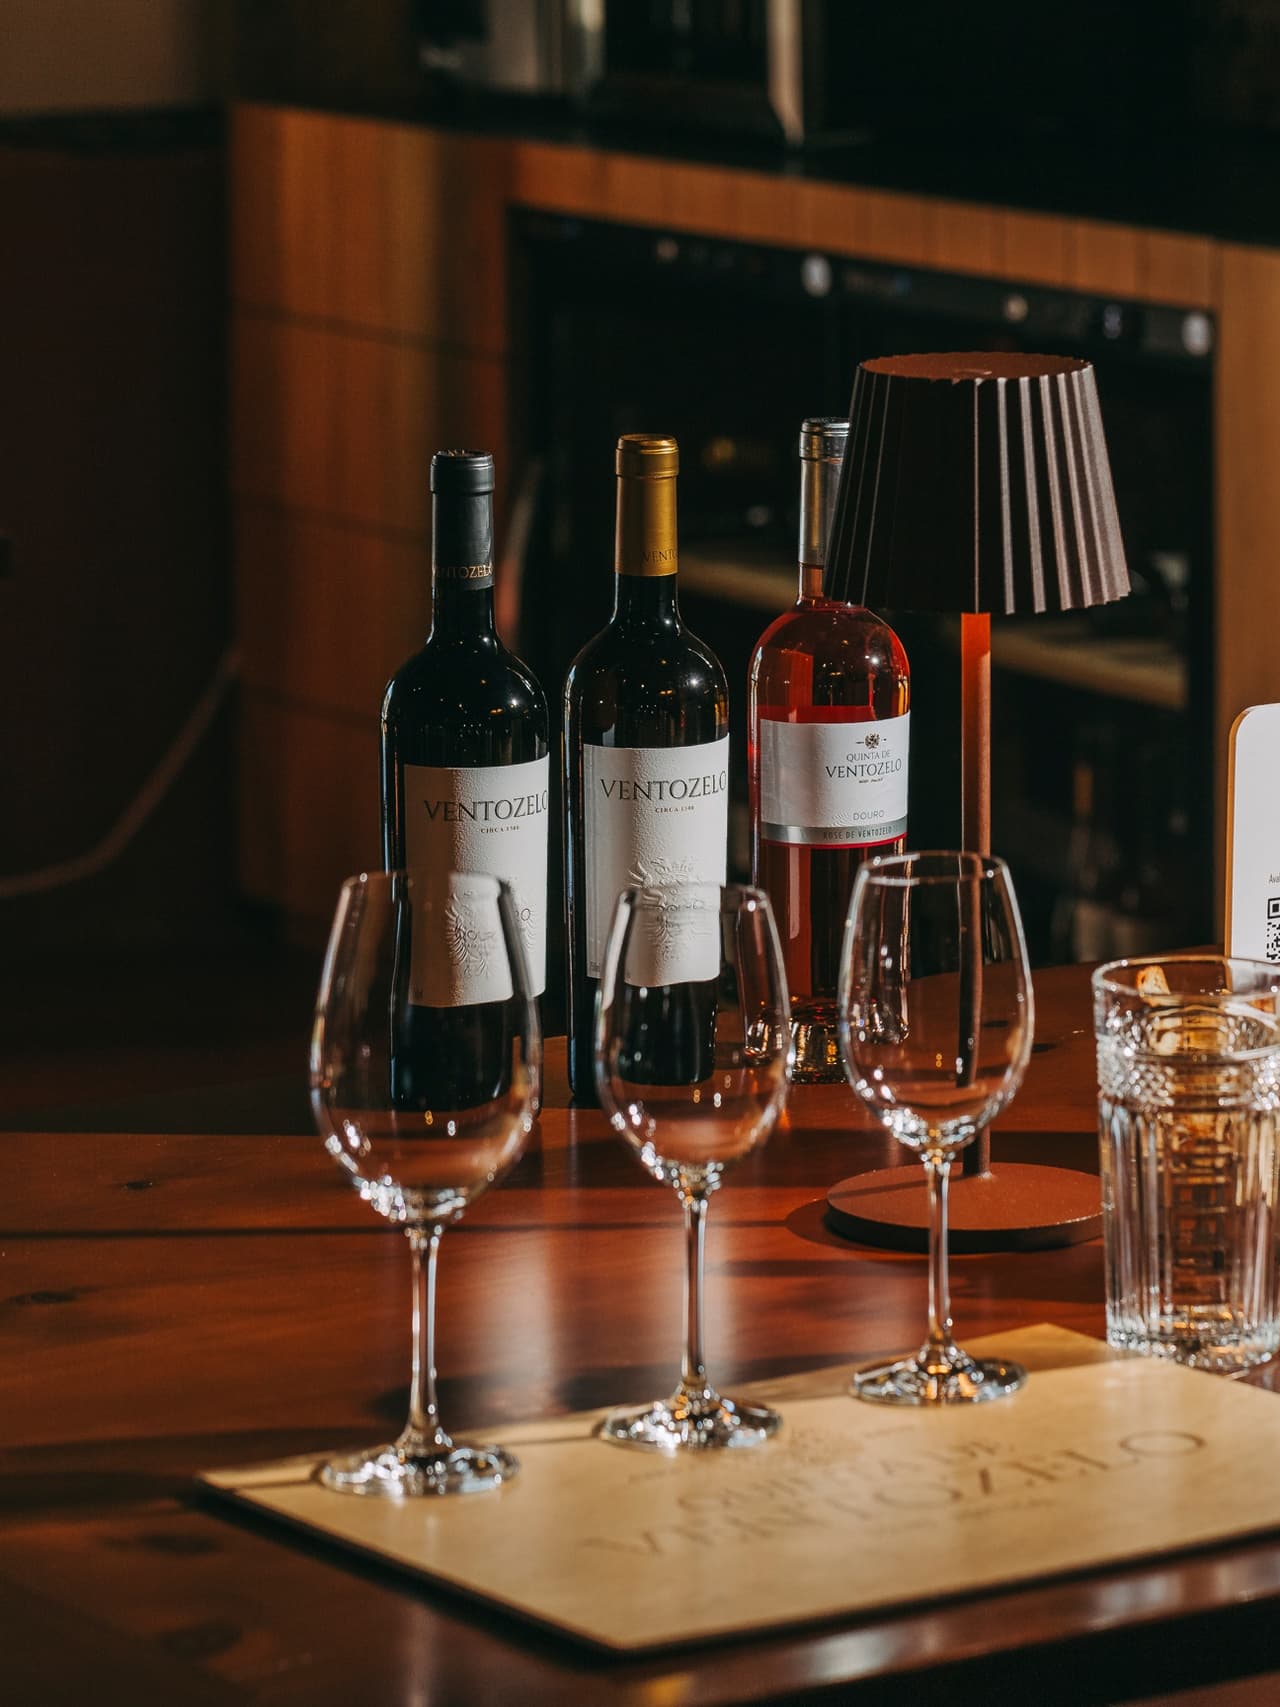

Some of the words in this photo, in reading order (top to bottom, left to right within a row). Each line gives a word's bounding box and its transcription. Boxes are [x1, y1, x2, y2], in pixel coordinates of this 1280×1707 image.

[846, 752, 880, 762] QUINTA
[881, 750, 891, 758] DE
[825, 759, 902, 778] VENTOZELO
[600, 770, 727, 801] VENTOZELO
[423, 789, 547, 821] VENTOZELO
[853, 810, 885, 821] DOURO
[845, 831, 855, 839] DE
[857, 826, 893, 838] VENTOZELO
